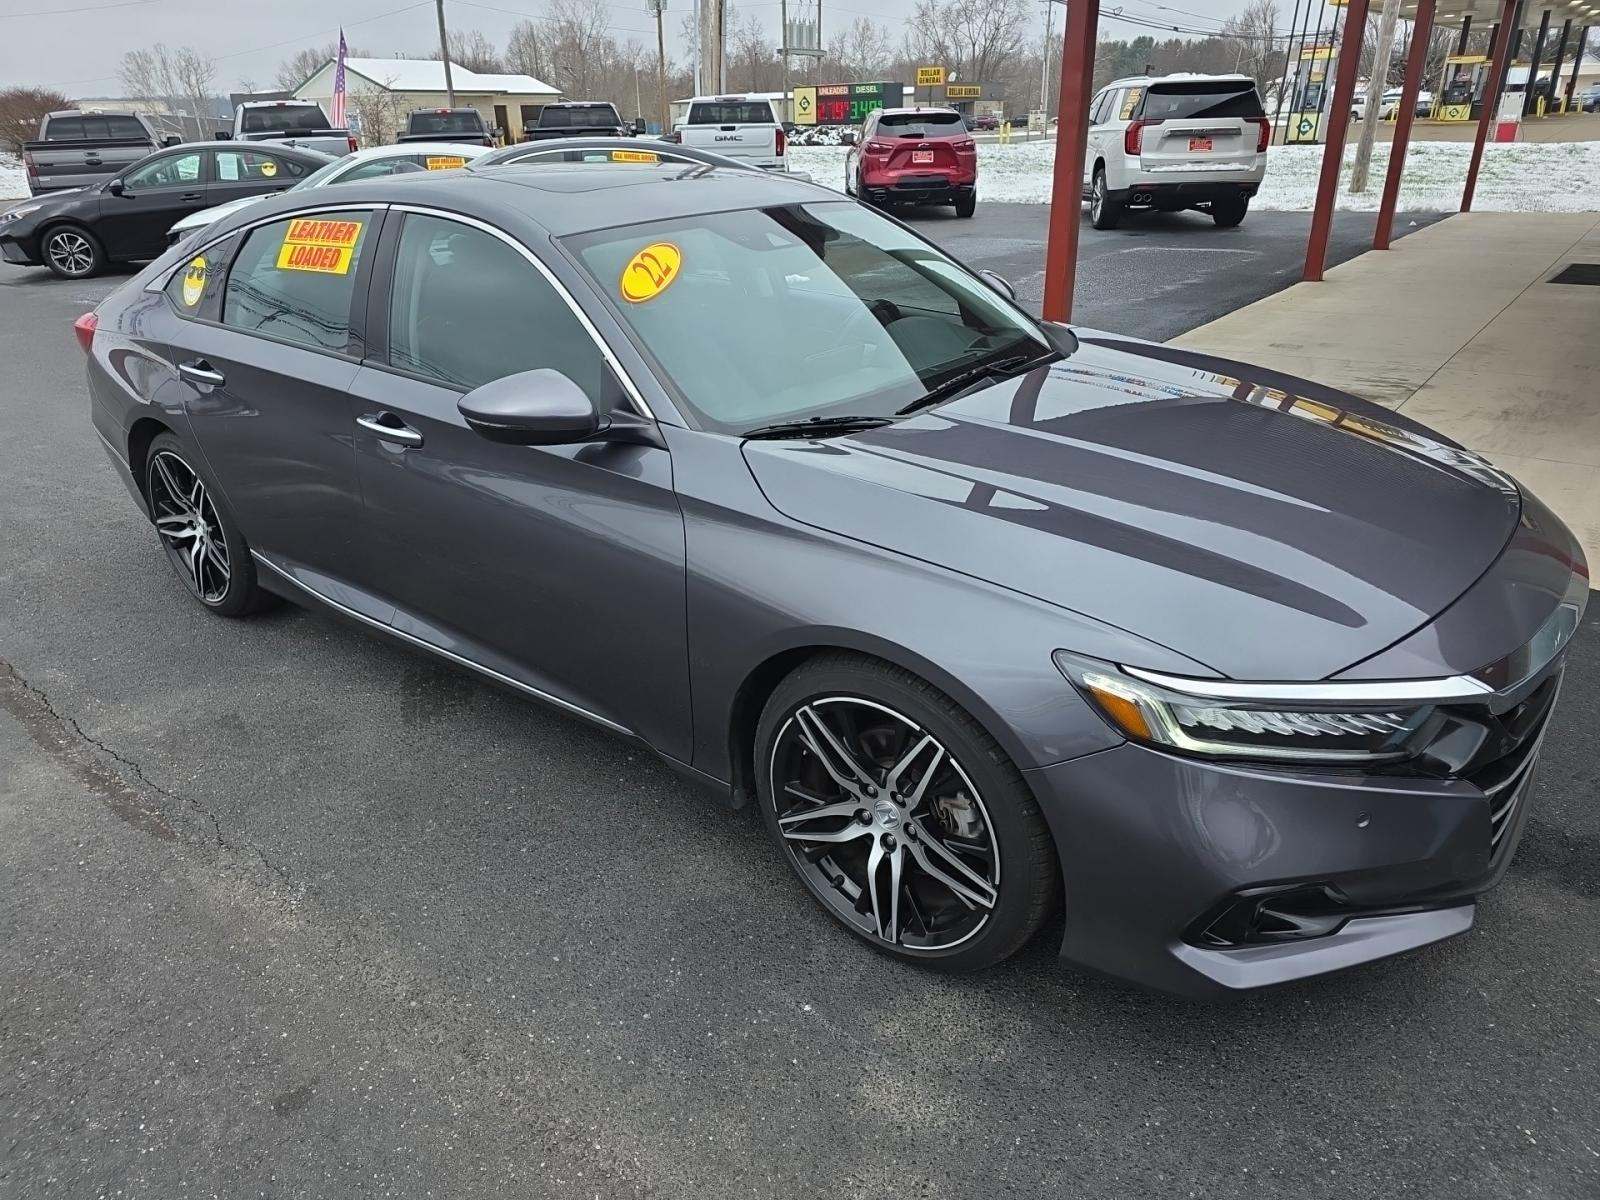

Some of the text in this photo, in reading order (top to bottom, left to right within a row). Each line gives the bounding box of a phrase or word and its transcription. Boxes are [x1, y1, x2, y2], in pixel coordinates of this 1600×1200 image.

[920, 69, 940, 77] DOLLAR
[919, 76, 942, 84] GENERAL
[819, 87, 848, 96] UNLEADED
[855, 85, 878, 93] DIESEL
[623, 152, 640, 160] WHEEL
[441, 157, 463, 165] MILEAGE
[289, 221, 357, 244] LEATHER
[287, 246, 342, 271] LOADED
[633, 252, 672, 288] 22
